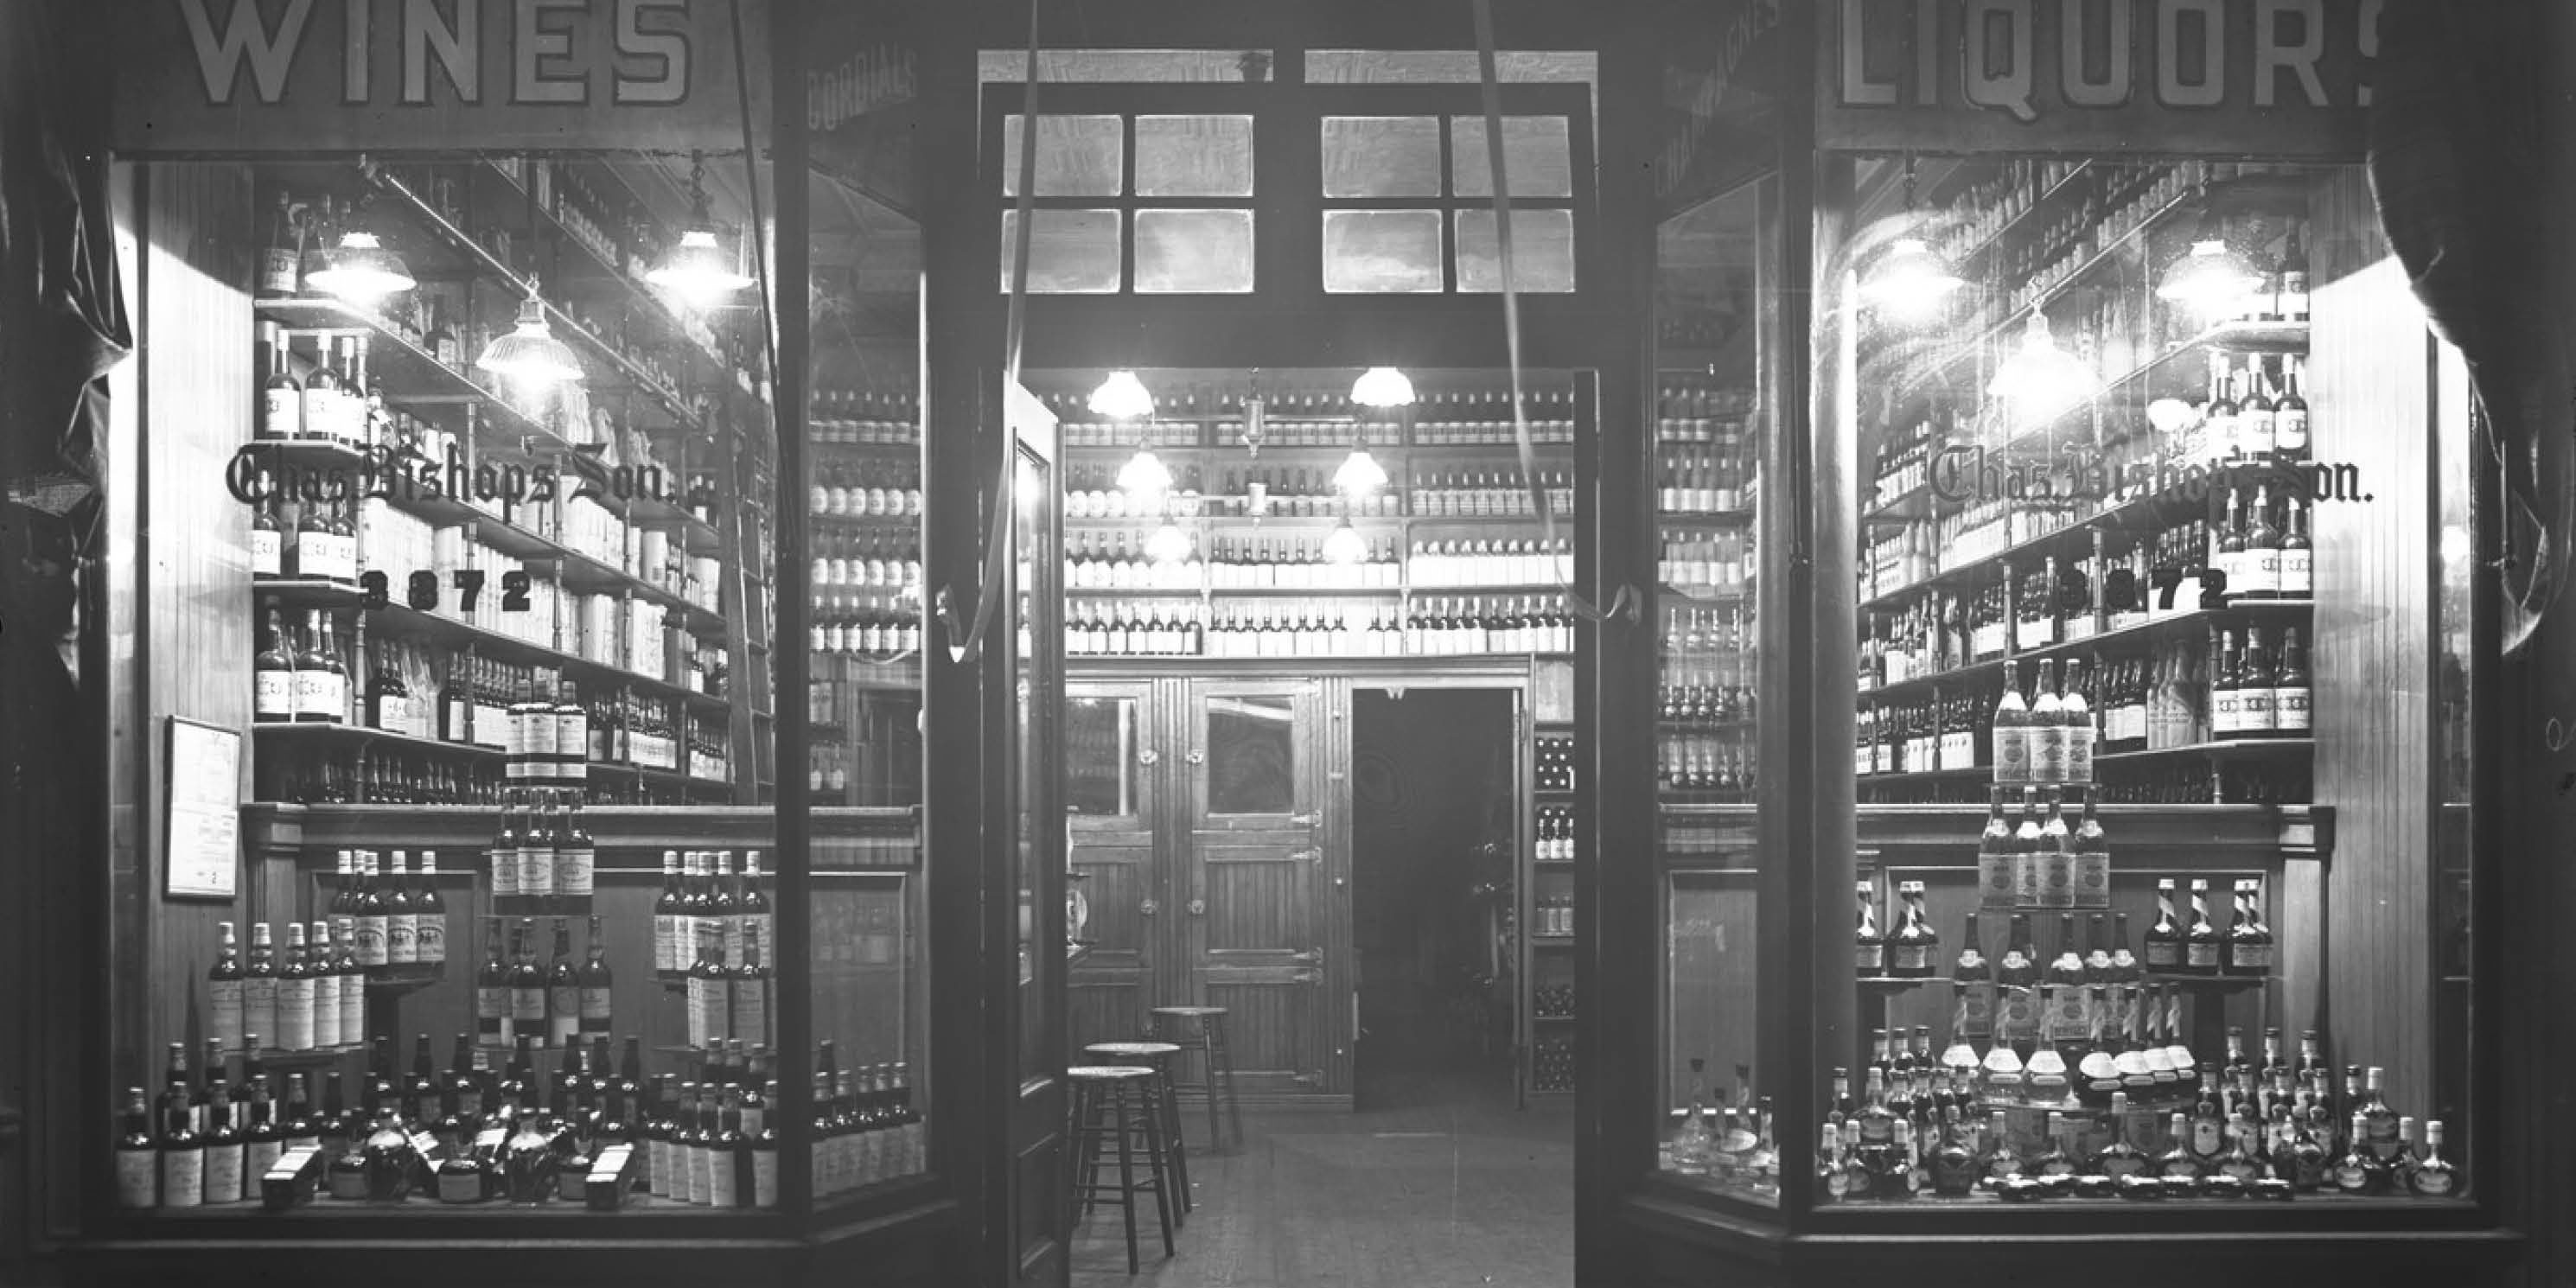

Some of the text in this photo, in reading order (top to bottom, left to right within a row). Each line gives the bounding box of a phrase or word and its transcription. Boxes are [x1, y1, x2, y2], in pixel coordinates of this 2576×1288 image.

[179, 0, 689, 105] WINES
[807, 41, 917, 131] CORDIALS
[359, 569, 530, 612] 3872
